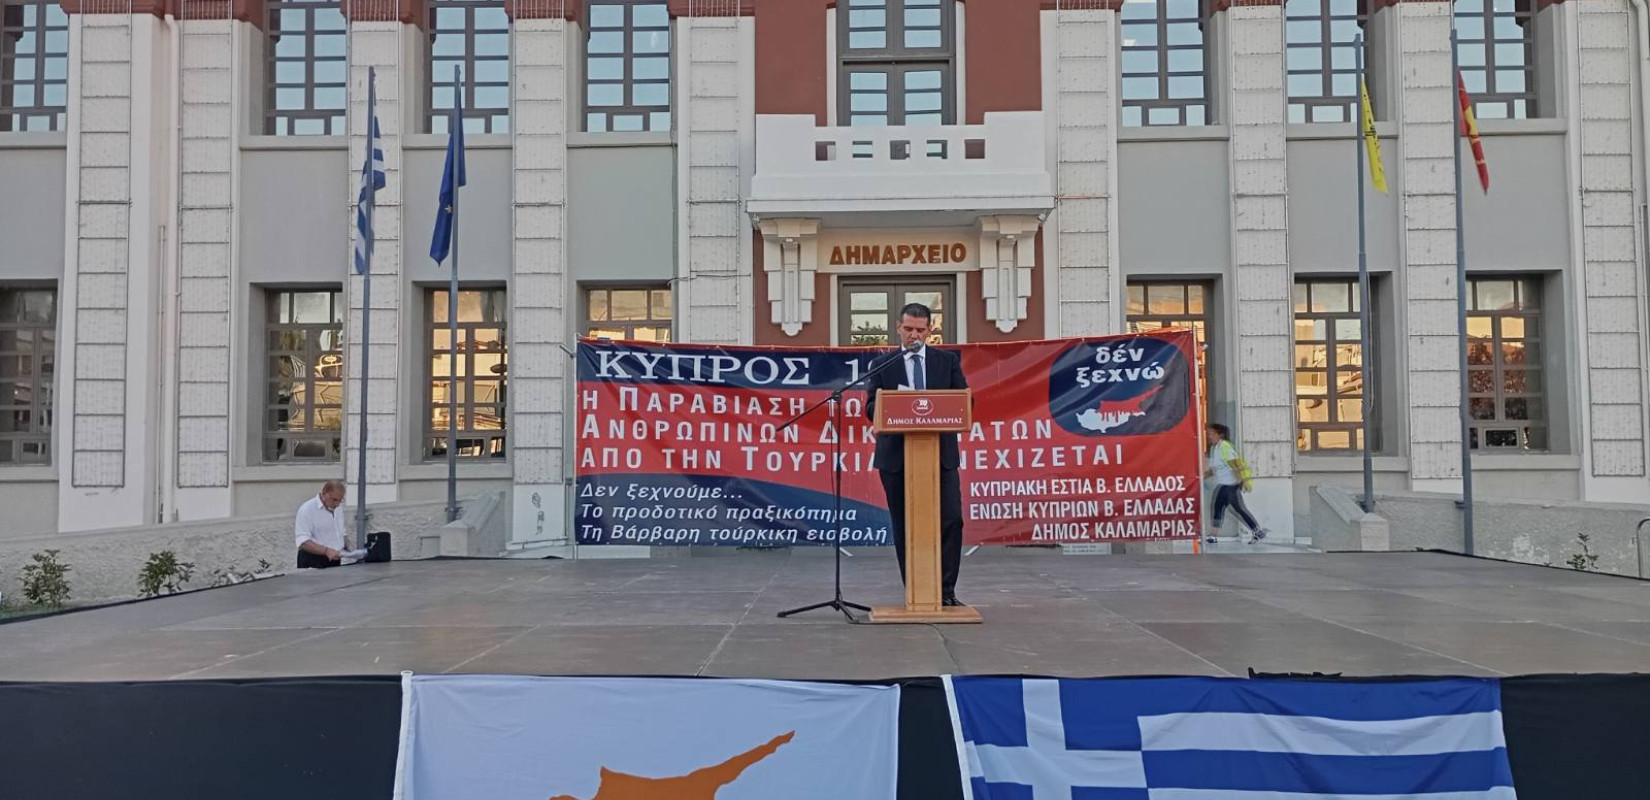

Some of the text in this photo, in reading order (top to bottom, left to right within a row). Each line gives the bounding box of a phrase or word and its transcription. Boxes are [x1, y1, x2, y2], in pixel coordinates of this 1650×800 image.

[829, 243, 967, 265] ΔΗΜΑΡΧΕΙΟ
[1096, 344, 1145, 363] δέν
[596, 350, 810, 385] ΚΥΠΡΟΣ
[1076, 361, 1165, 388] ξεχνώ
[619, 386, 805, 416] ΠΑΡΑΒΙΑΣΗ
[827, 397, 862, 418] ΤΩ
[582, 414, 1052, 444] ΑΝΘΡΩΠΙΝΩΝ ΔΙΚΑΤΩΝ
[916, 417, 963, 425] ΚΑΛΑΜΑΡΙΑΣ
[581, 447, 642, 469] ΑΠΟ
[662, 448, 721, 470] ΤΗΝ
[580, 483, 743, 502] Δεν ξεχνούμε...
[970, 476, 1186, 497] ΚΥΠΡΙΑΚΗ ΕΣΤΙΑ Β. ΕΛΛΑΔΟΣ
[581, 504, 857, 524] Το προδοτικό πραξικόπημα
[970, 497, 1196, 520] ΕΝΩΣΗ ΚΥΠΡΙΩΝ Β. ΕΛΛΑΔΑΣ
[581, 525, 602, 542] Τη
[611, 525, 699, 544] Βάρβαρη
[807, 525, 888, 544] εισβολή
[1031, 519, 1196, 541] ΔΗΜΟΣ ΚΑΛΑΜΑΡΙΑΣ
